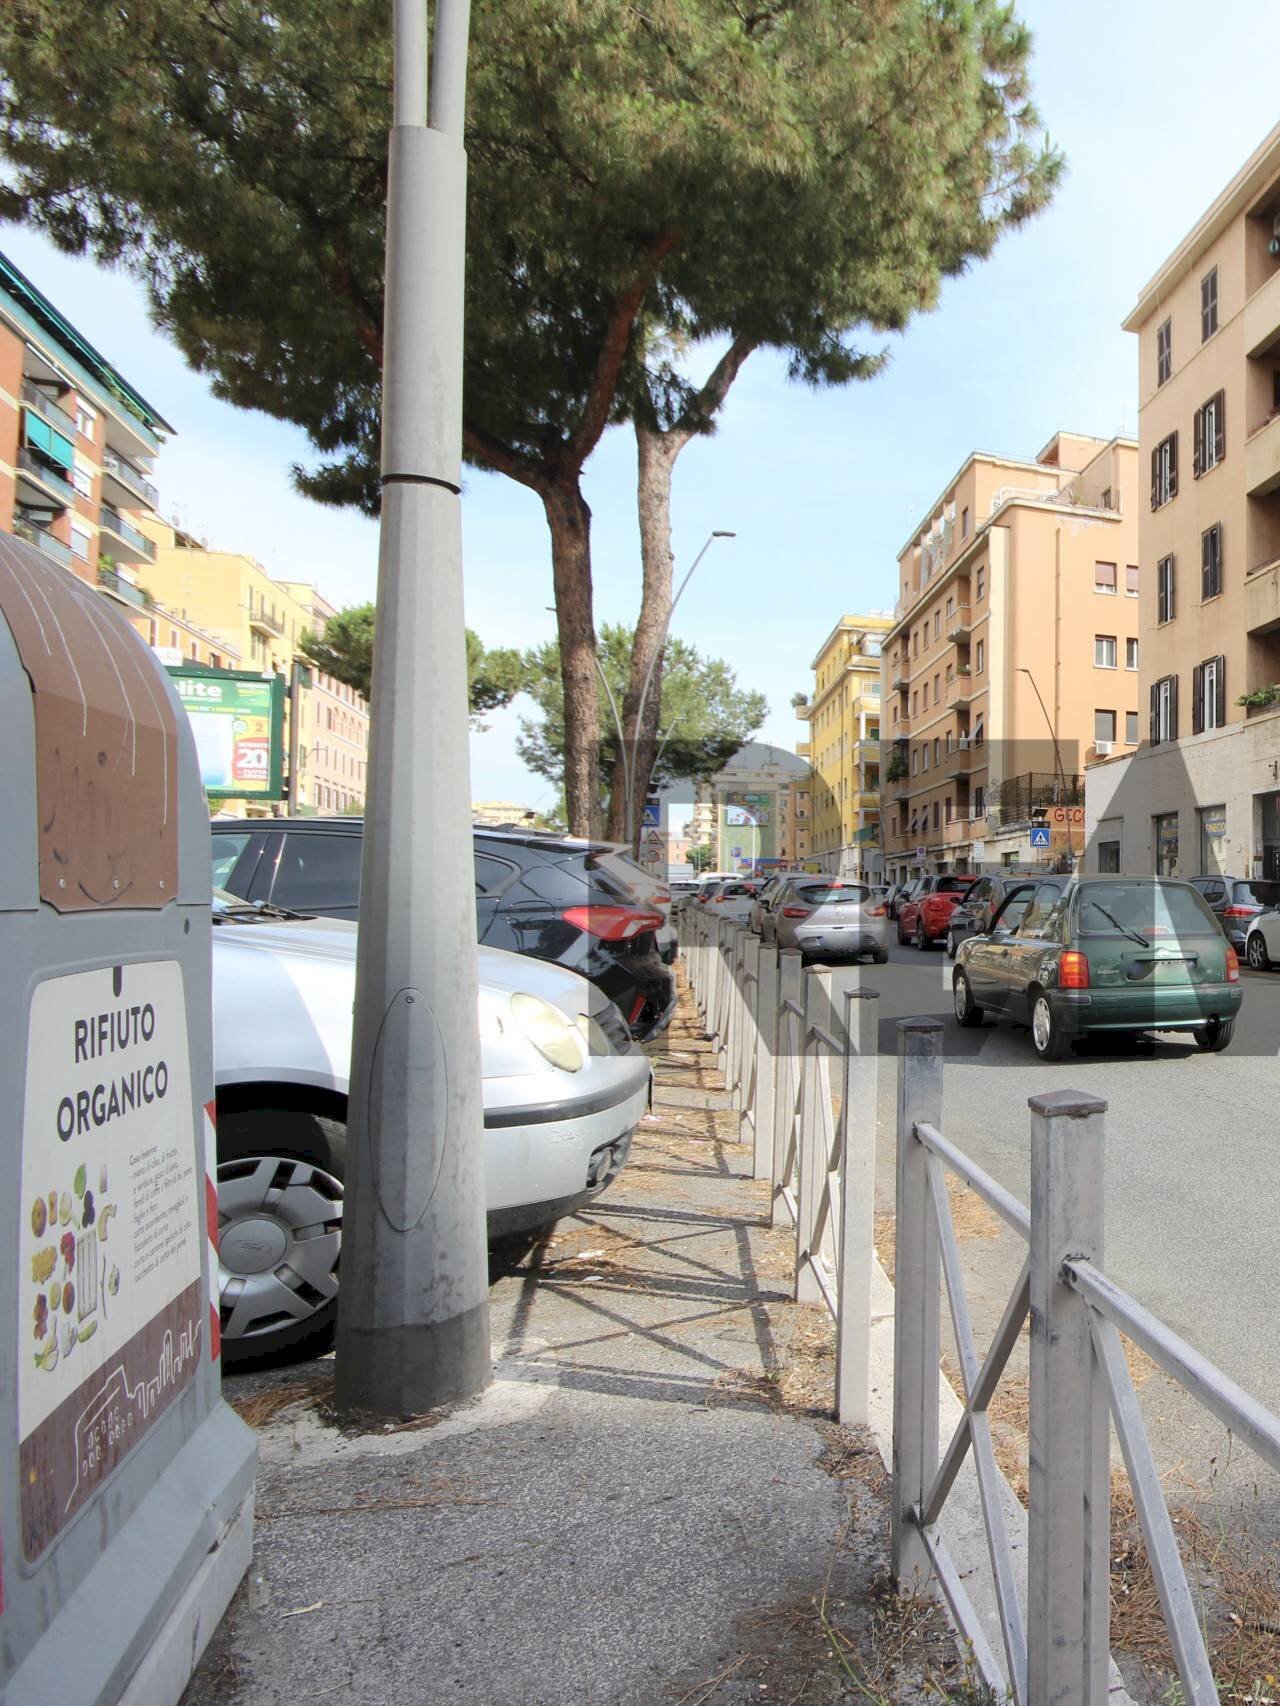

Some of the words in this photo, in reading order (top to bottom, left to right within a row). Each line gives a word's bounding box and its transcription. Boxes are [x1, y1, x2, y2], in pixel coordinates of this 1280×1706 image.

[174, 680, 222, 697] lite
[1054, 808, 1085, 823] GEC
[75, 1003, 155, 1063] RIFIUTO
[57, 1061, 168, 1142] ORGANICO
